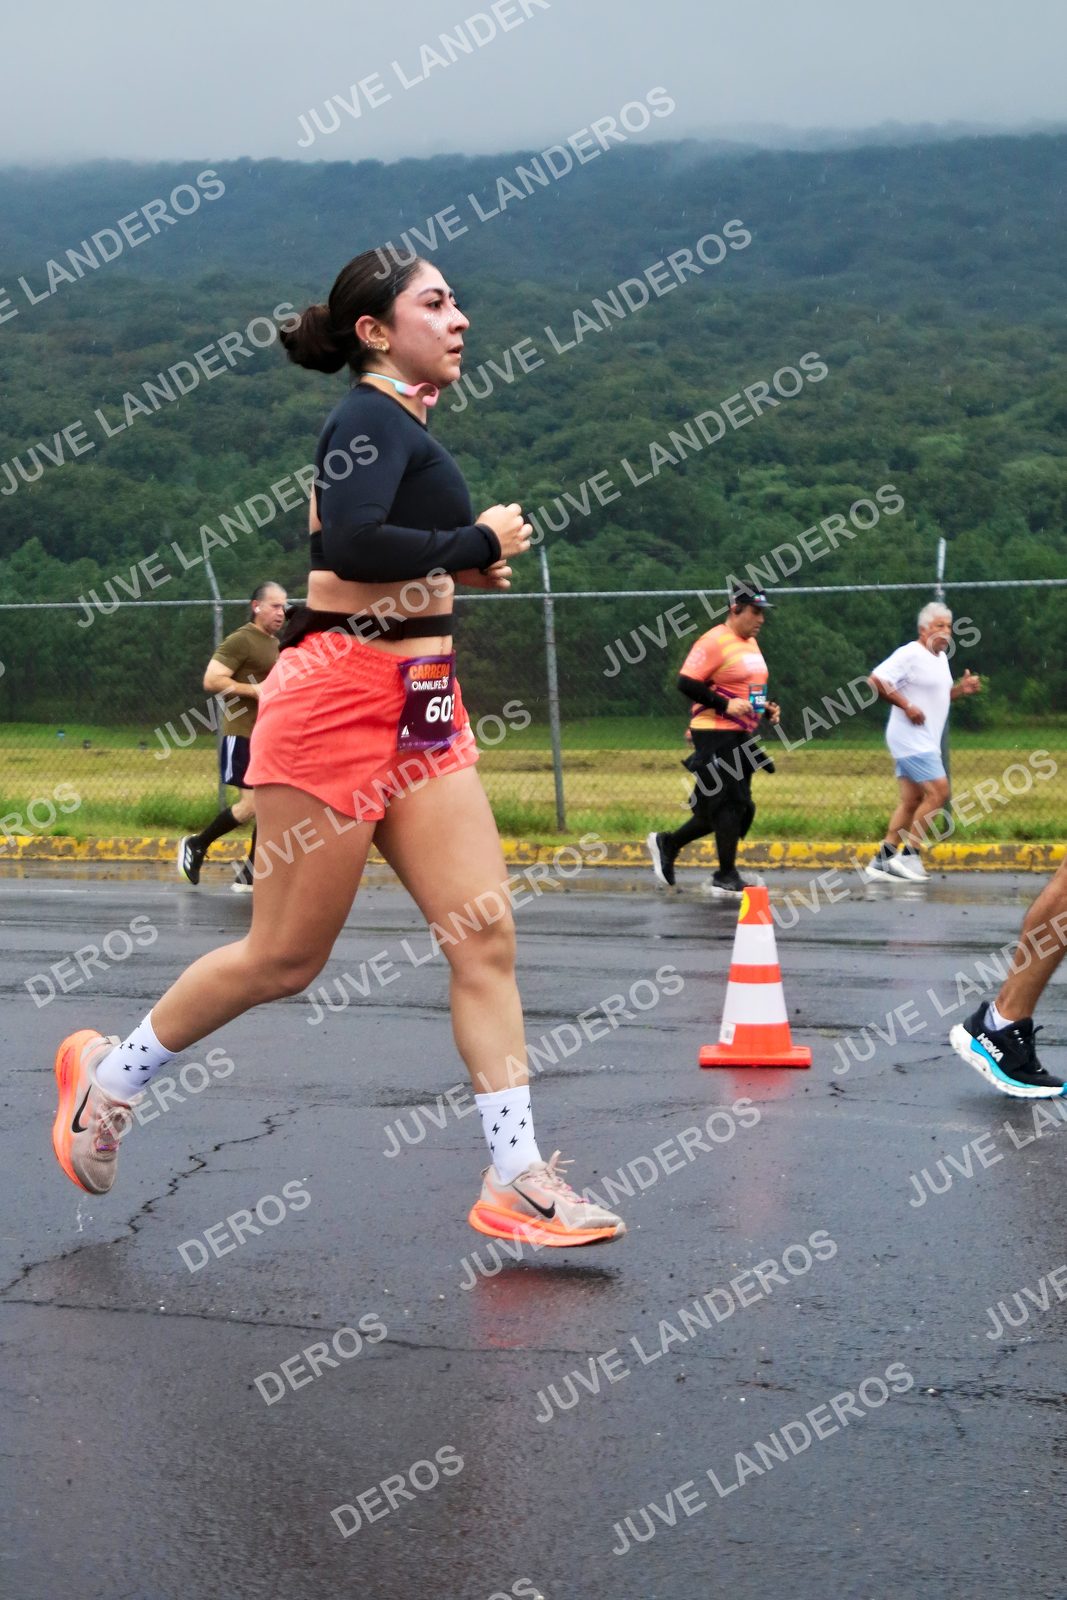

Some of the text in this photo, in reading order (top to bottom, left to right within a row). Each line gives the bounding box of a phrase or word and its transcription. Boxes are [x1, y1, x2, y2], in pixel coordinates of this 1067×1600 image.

[409, 664, 450, 680] CARRERA
[412, 681, 442, 691] OMNILIFE
[976, 1033, 1004, 1063] HOKA
